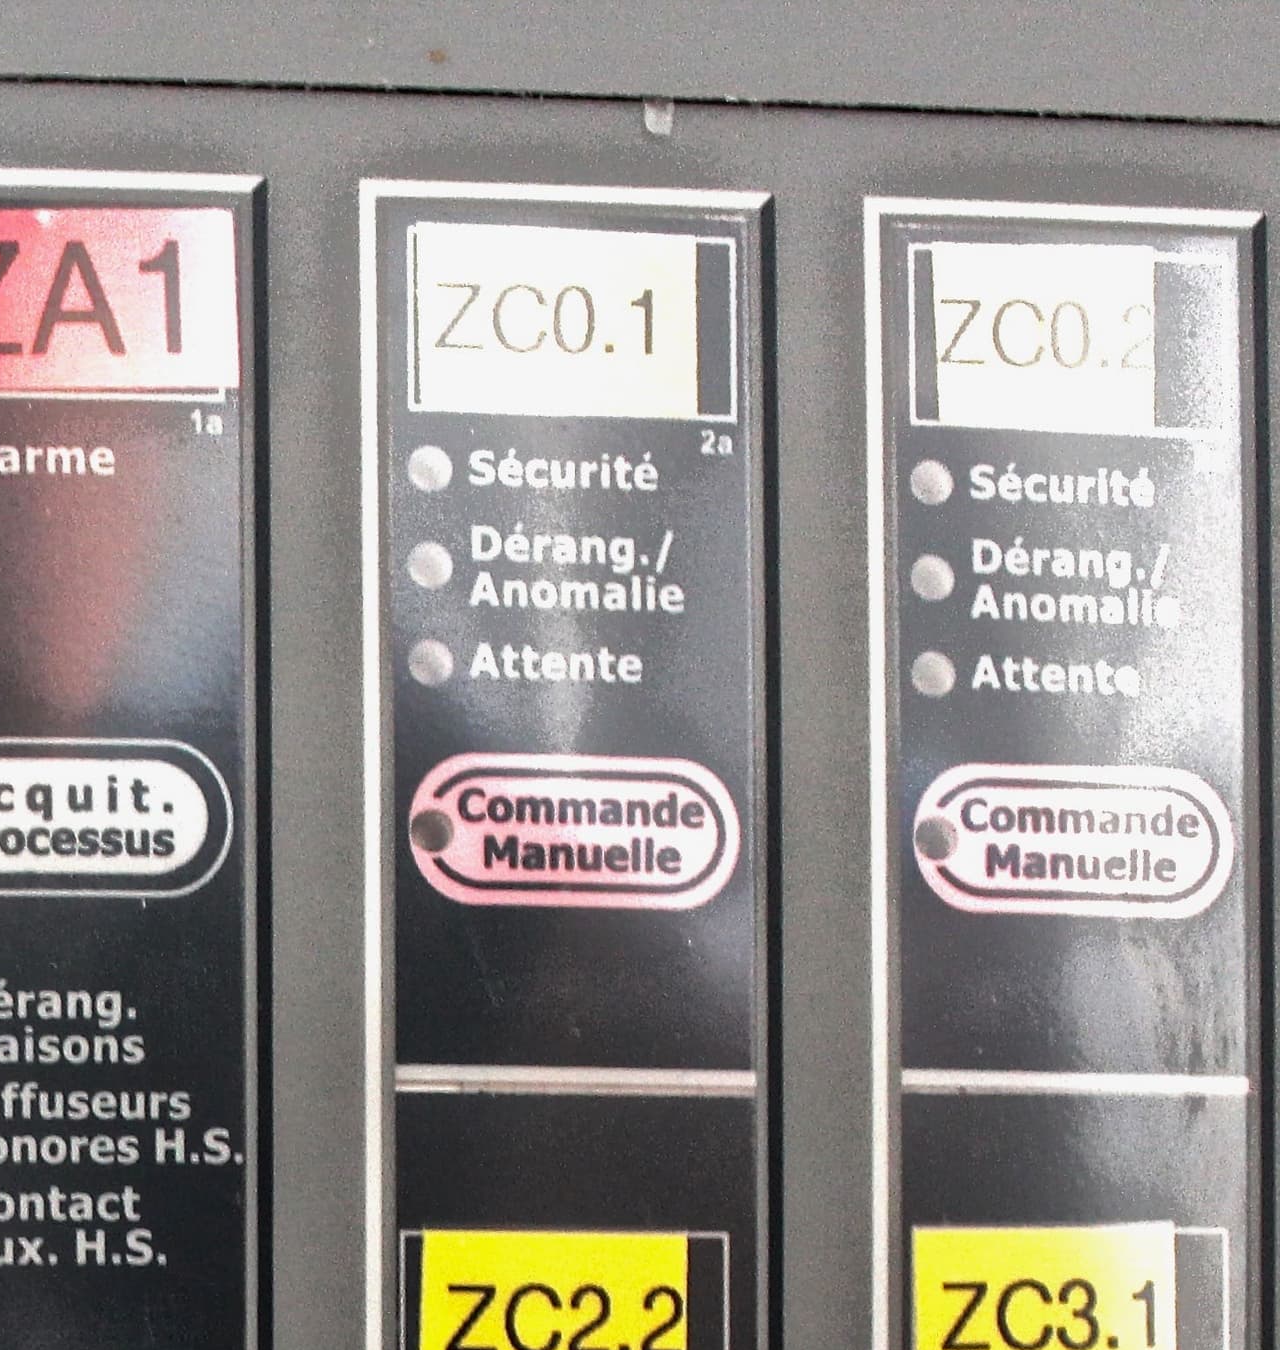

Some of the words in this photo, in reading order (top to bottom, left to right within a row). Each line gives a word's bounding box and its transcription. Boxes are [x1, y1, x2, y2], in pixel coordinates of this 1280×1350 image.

[435, 283, 653, 355] ZC0.1
[939, 299, 1153, 369] ZC0.2
[191, 409, 223, 435] 1a
[700, 429, 733, 455] 2a
[469, 448, 657, 494] Sécurité
[969, 462, 1155, 507] Sécurité
[469, 577, 684, 612] Anomalie
[971, 584, 1179, 626] Anomalie
[470, 643, 642, 687] Attente
[971, 654, 1140, 695] Attente
[457, 786, 707, 828] Commande
[960, 795, 1200, 838] Commande
[483, 835, 680, 873] Manuelle
[985, 844, 1175, 882] Manuelle
[156, 1128, 243, 1164] H.S.
[77, 1229, 166, 1265] H.S.
